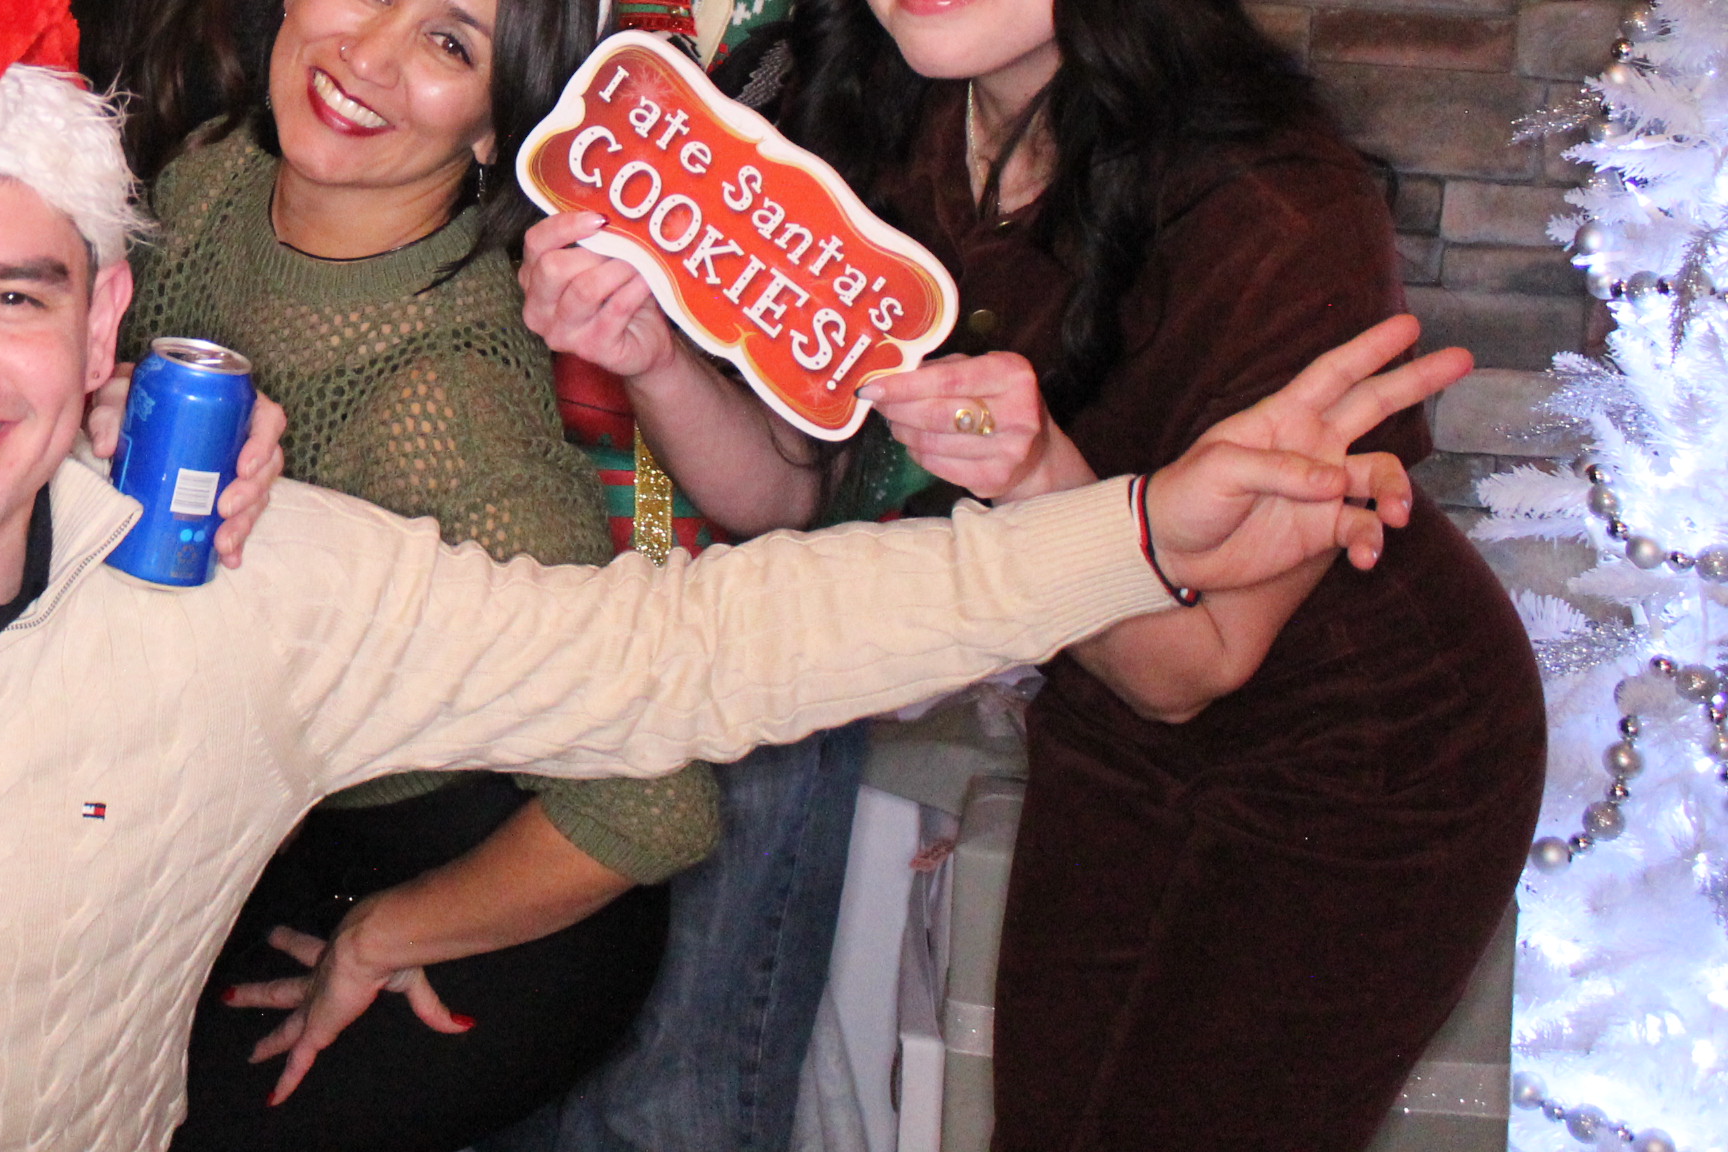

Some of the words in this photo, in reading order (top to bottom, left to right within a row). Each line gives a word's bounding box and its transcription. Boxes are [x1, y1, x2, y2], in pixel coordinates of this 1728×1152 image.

[568, 125, 872, 391] COOKIES!
[598, 65, 630, 103] I
[628, 94, 712, 174] ate
[721, 164, 904, 332] Santa's
